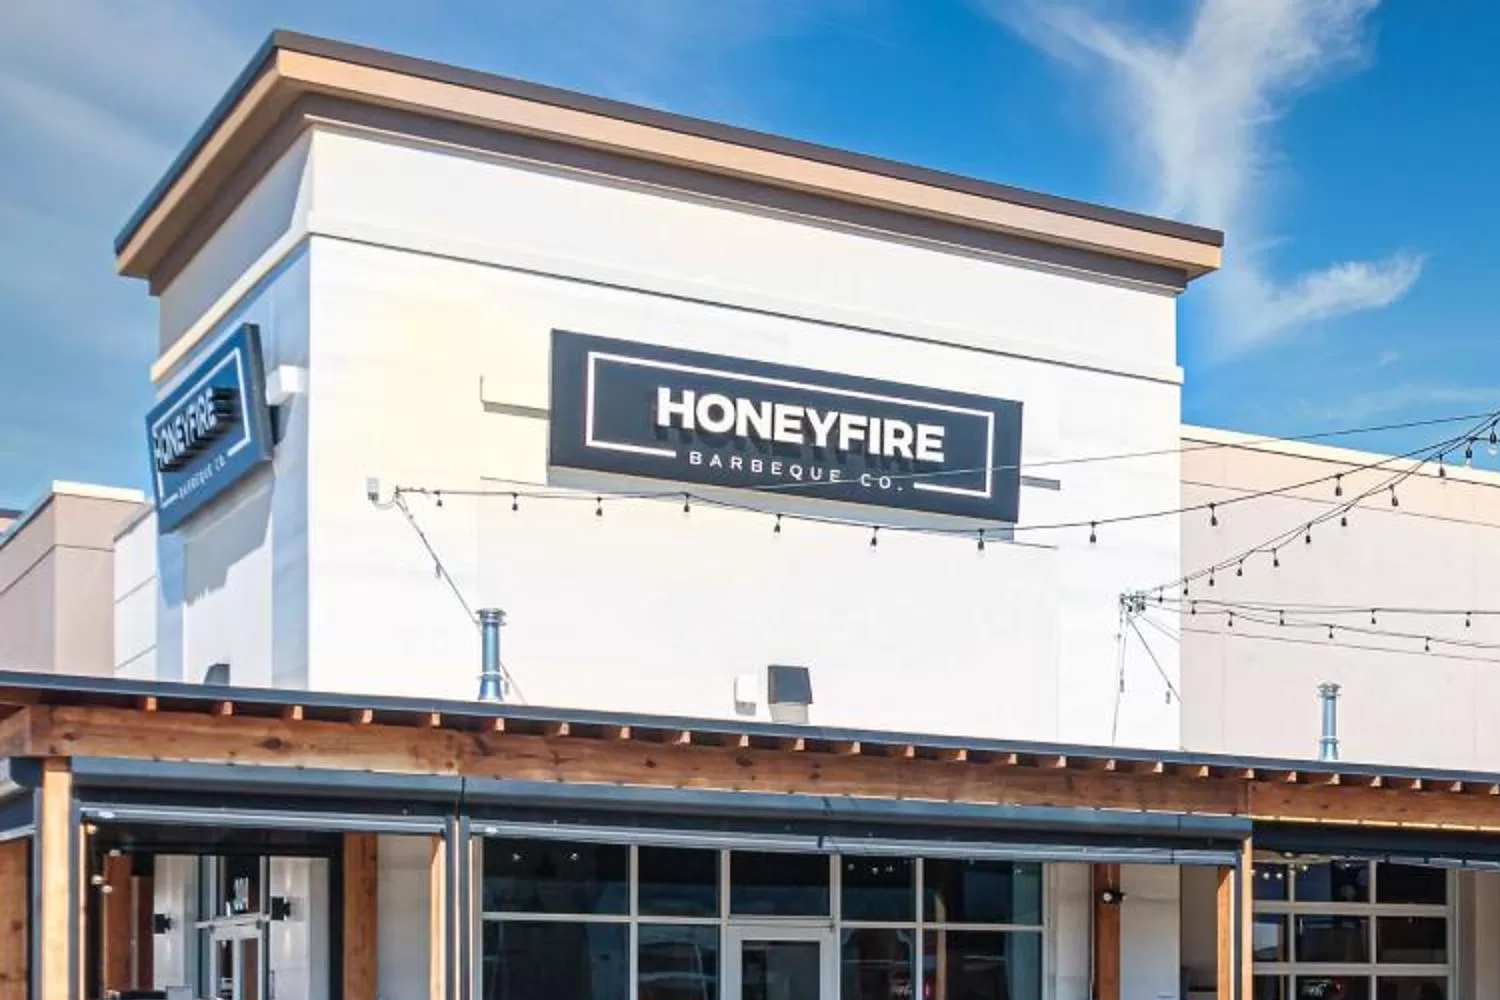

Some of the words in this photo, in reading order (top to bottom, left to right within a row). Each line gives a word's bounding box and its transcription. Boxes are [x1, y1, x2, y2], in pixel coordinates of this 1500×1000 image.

[657, 387, 945, 463] HONEYFIRE
[689, 450, 841, 482] BARBEQUE
[860, 472, 903, 491] CO.
